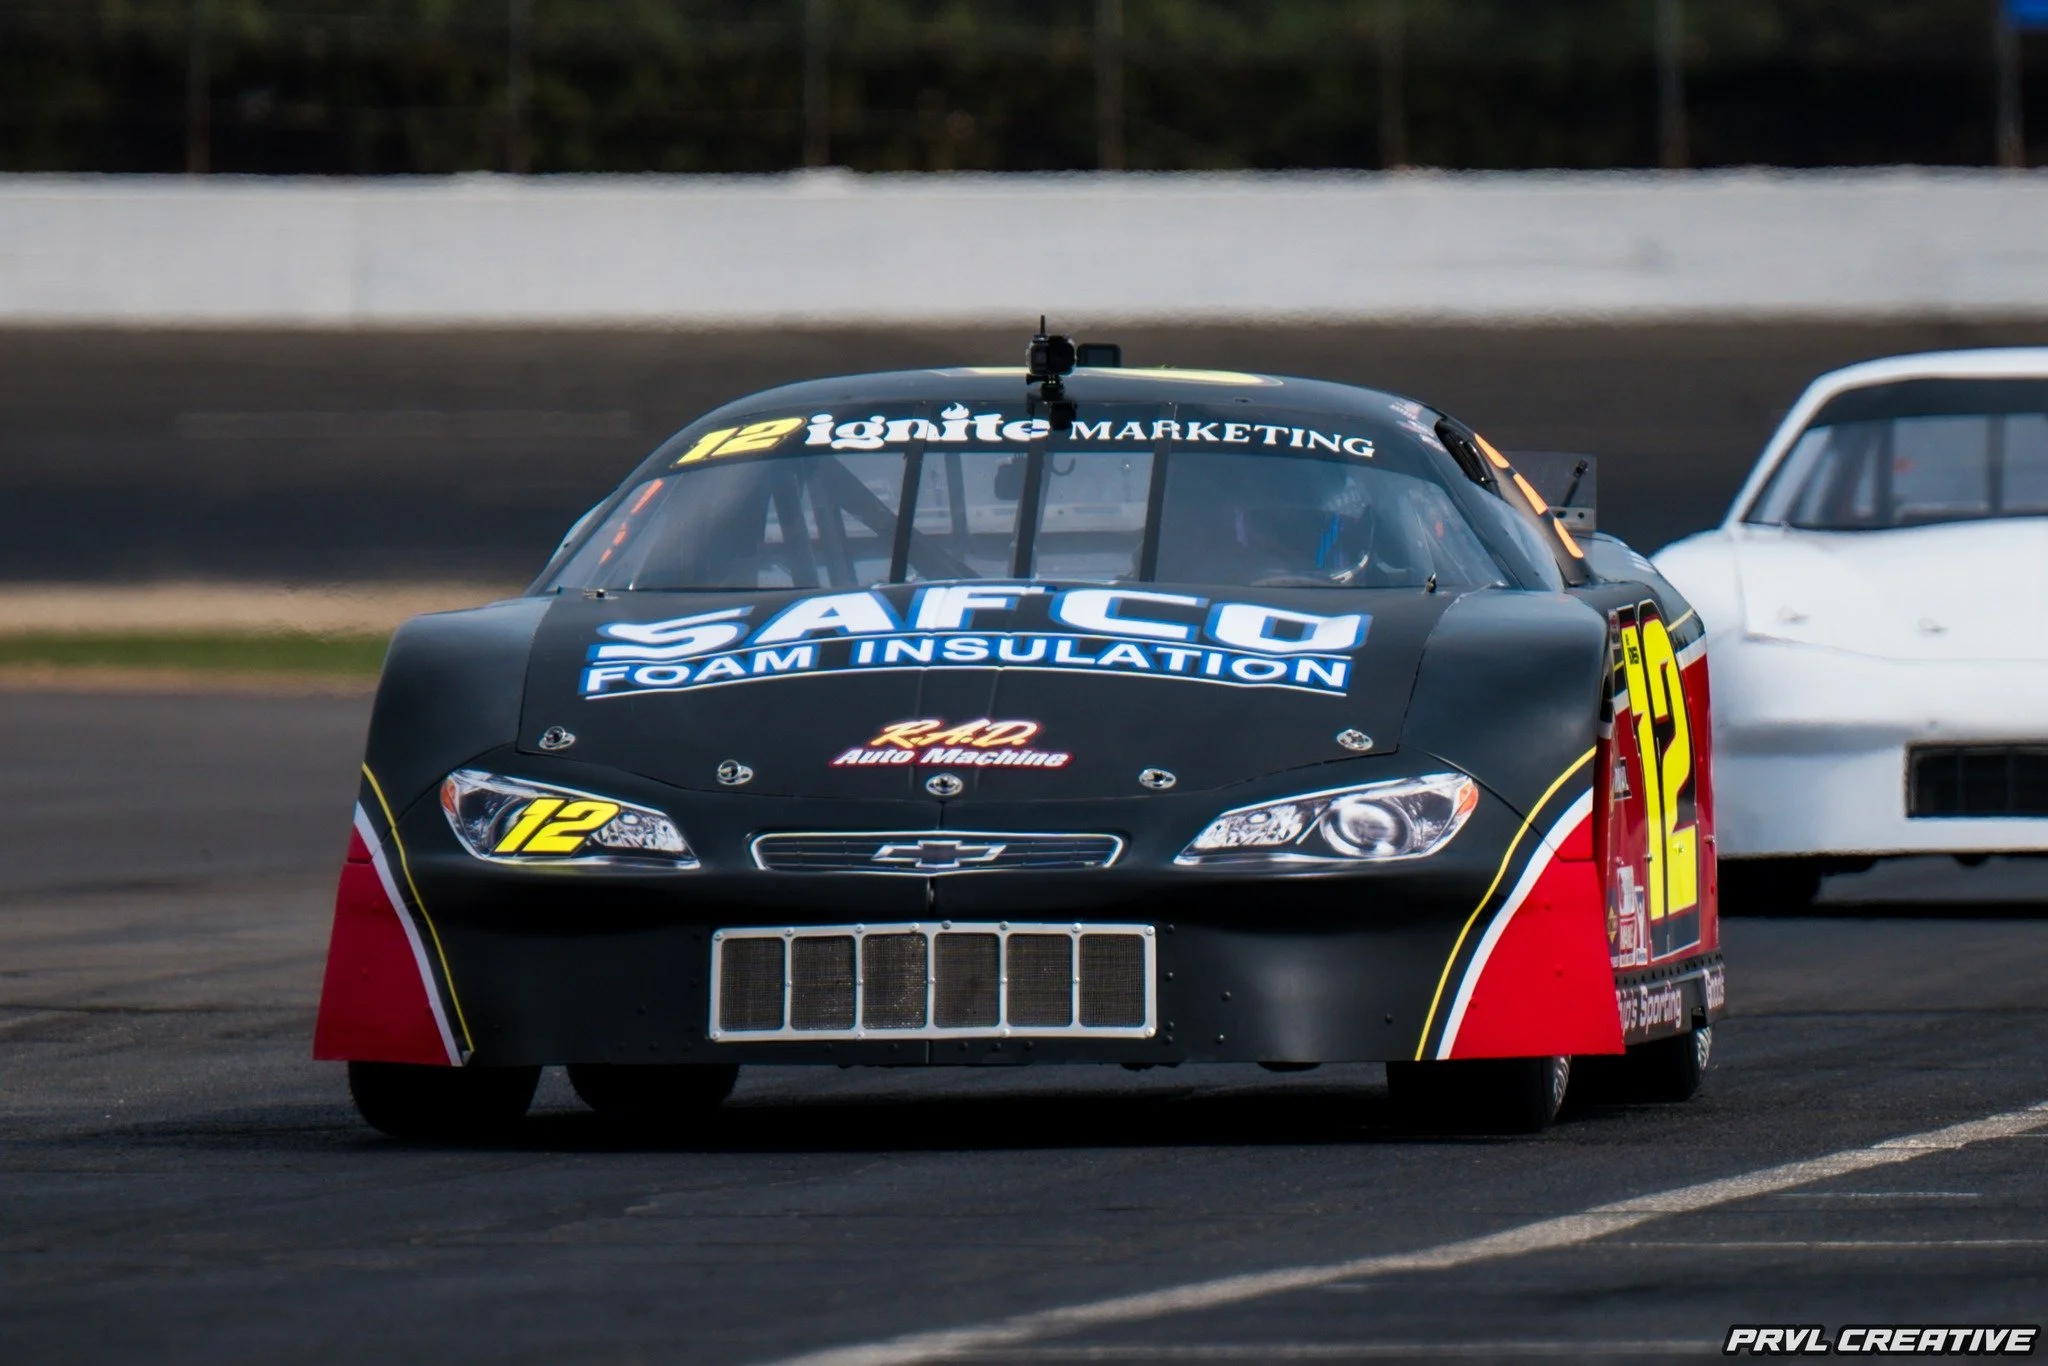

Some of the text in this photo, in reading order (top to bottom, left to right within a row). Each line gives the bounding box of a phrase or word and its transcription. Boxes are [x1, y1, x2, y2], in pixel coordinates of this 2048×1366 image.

[672, 417, 805, 466] 12
[805, 402, 1050, 449] ignite
[1070, 419, 1375, 457] MARKETING
[588, 585, 1371, 661] SAFCO
[580, 636, 1350, 695] FOAM INSULATION
[833, 747, 1069, 768] Auto Machine
[1619, 612, 1698, 926] 12
[493, 796, 621, 855] 12
